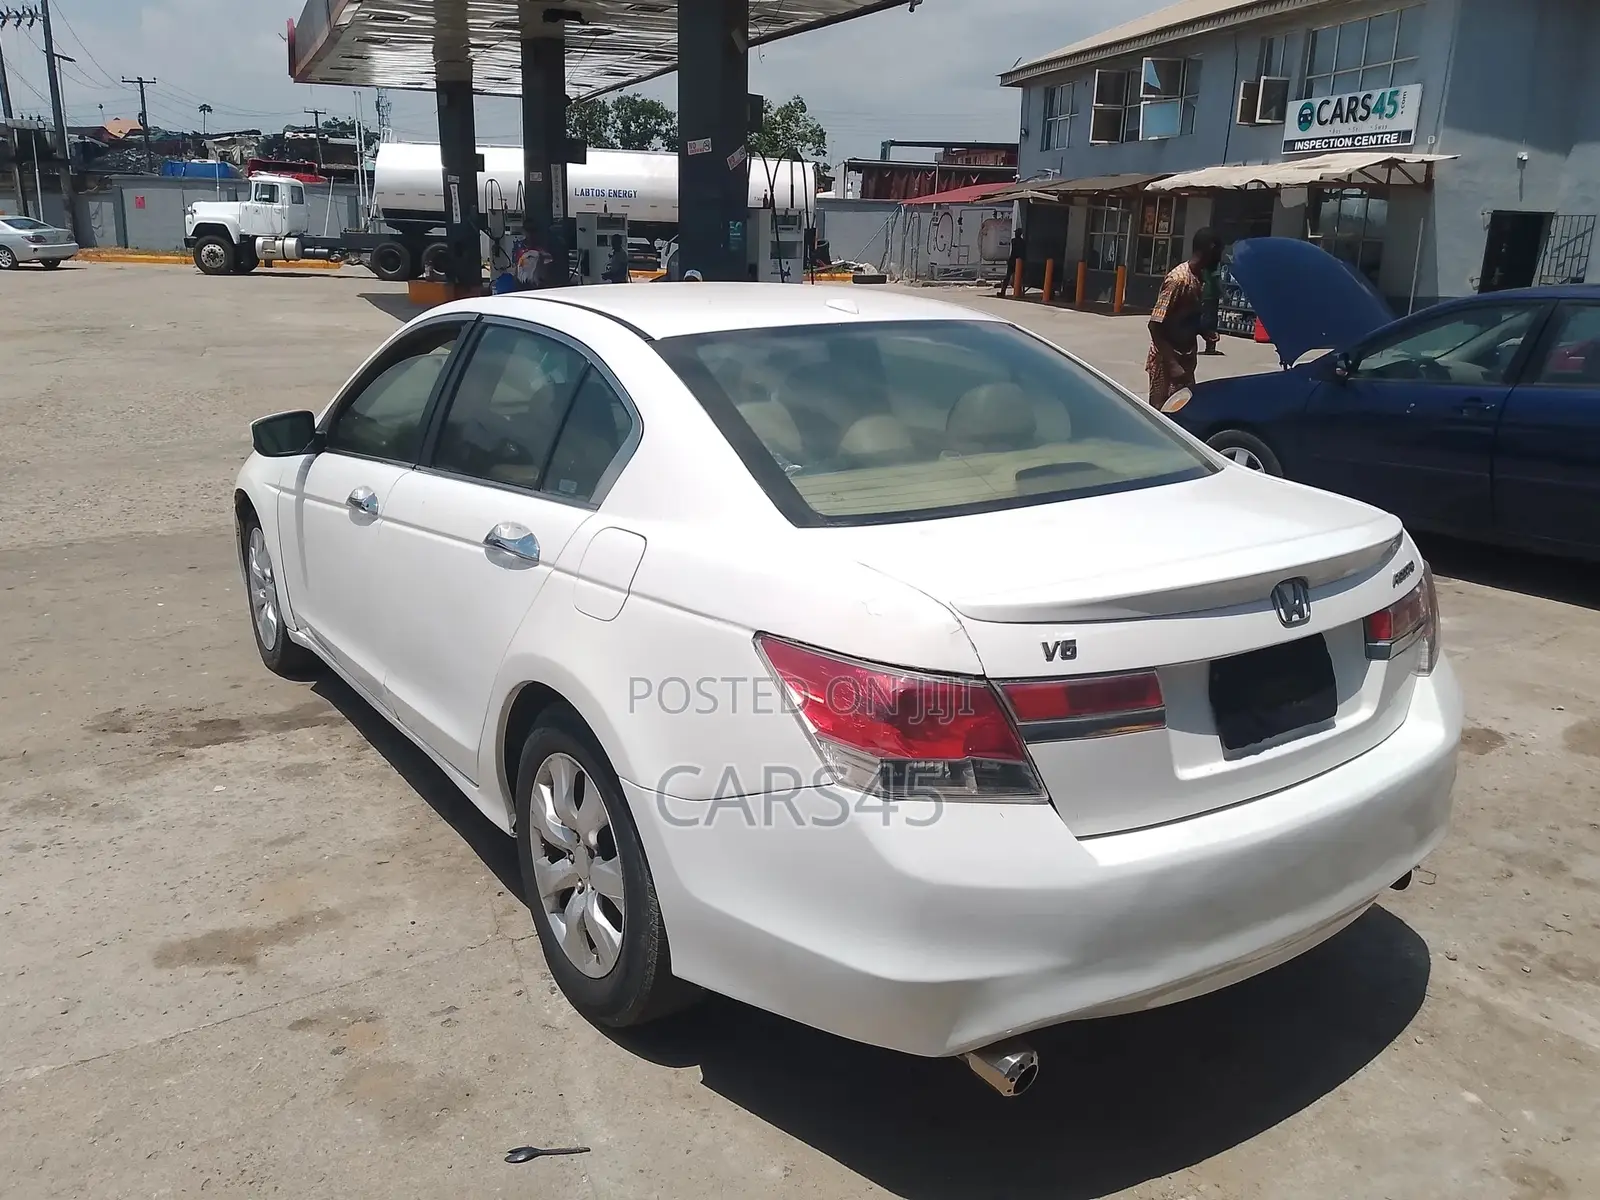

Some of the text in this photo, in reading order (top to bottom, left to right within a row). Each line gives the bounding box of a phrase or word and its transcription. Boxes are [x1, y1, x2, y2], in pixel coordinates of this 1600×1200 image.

[1316, 90, 1399, 126] CARS45
[1294, 132, 1399, 151] INSPECTION CENTRE
[574, 187, 638, 199] LABTOS ENERGY
[1041, 638, 1078, 662] V6
